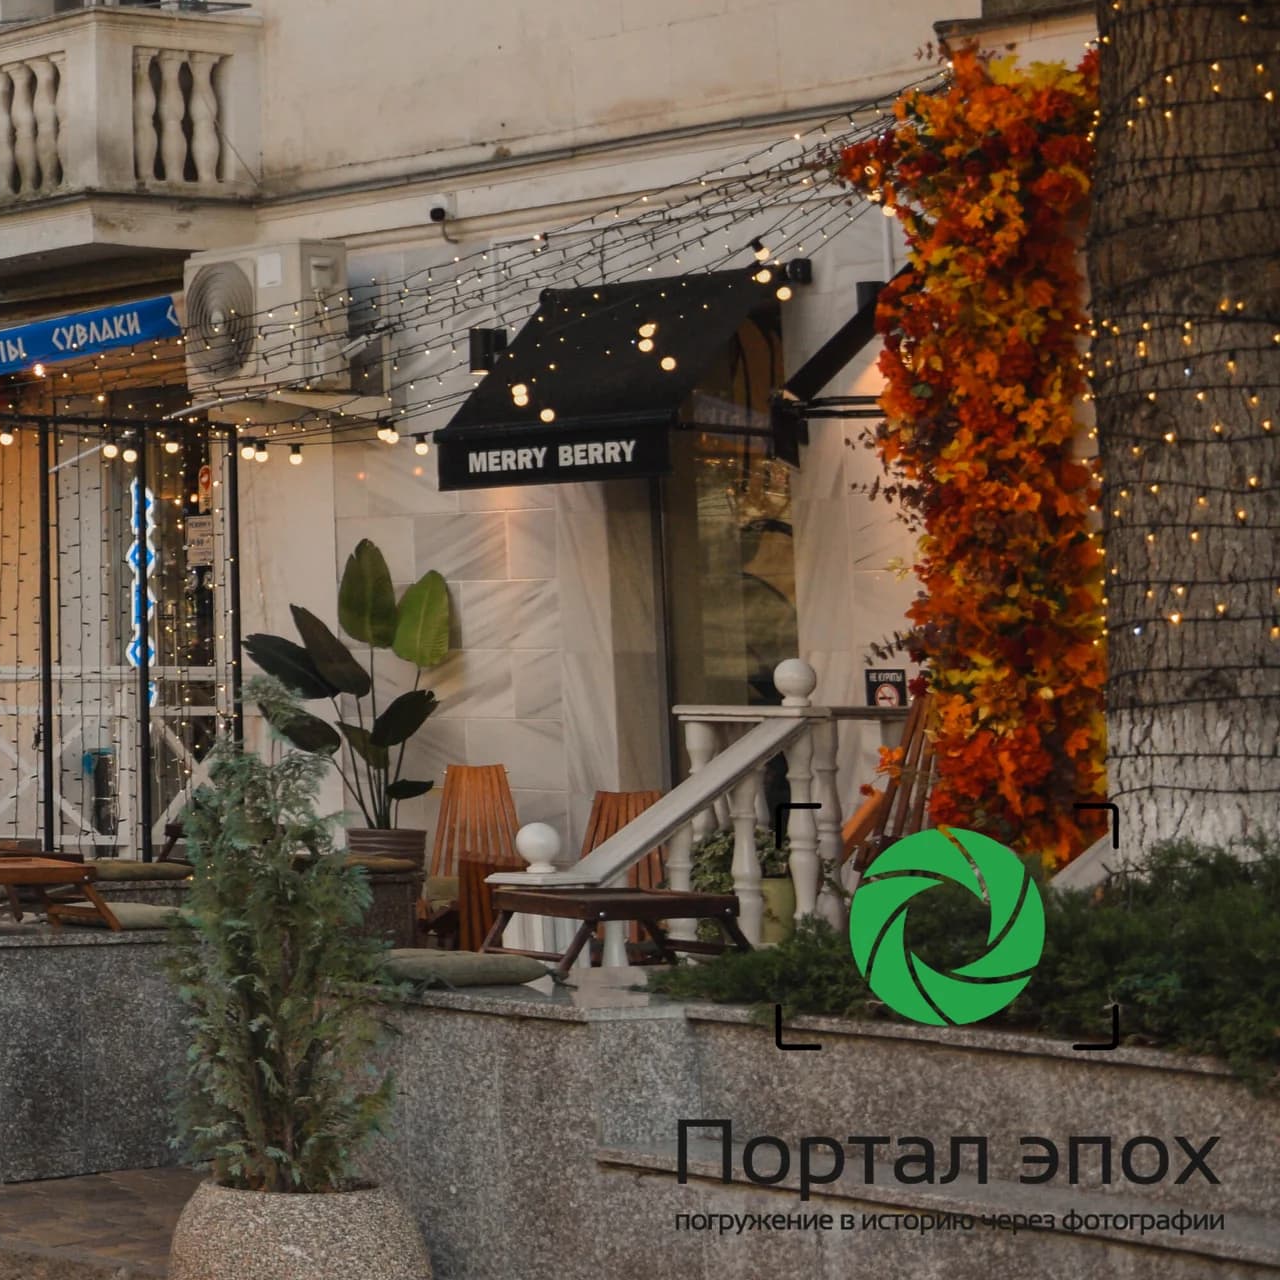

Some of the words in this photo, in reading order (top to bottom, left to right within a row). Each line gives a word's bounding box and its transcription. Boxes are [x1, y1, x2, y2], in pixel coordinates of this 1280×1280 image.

[51, 311, 142, 351] СУВЛАКИ
[468, 446, 547, 473] MERRY
[558, 440, 637, 467] BERRY
